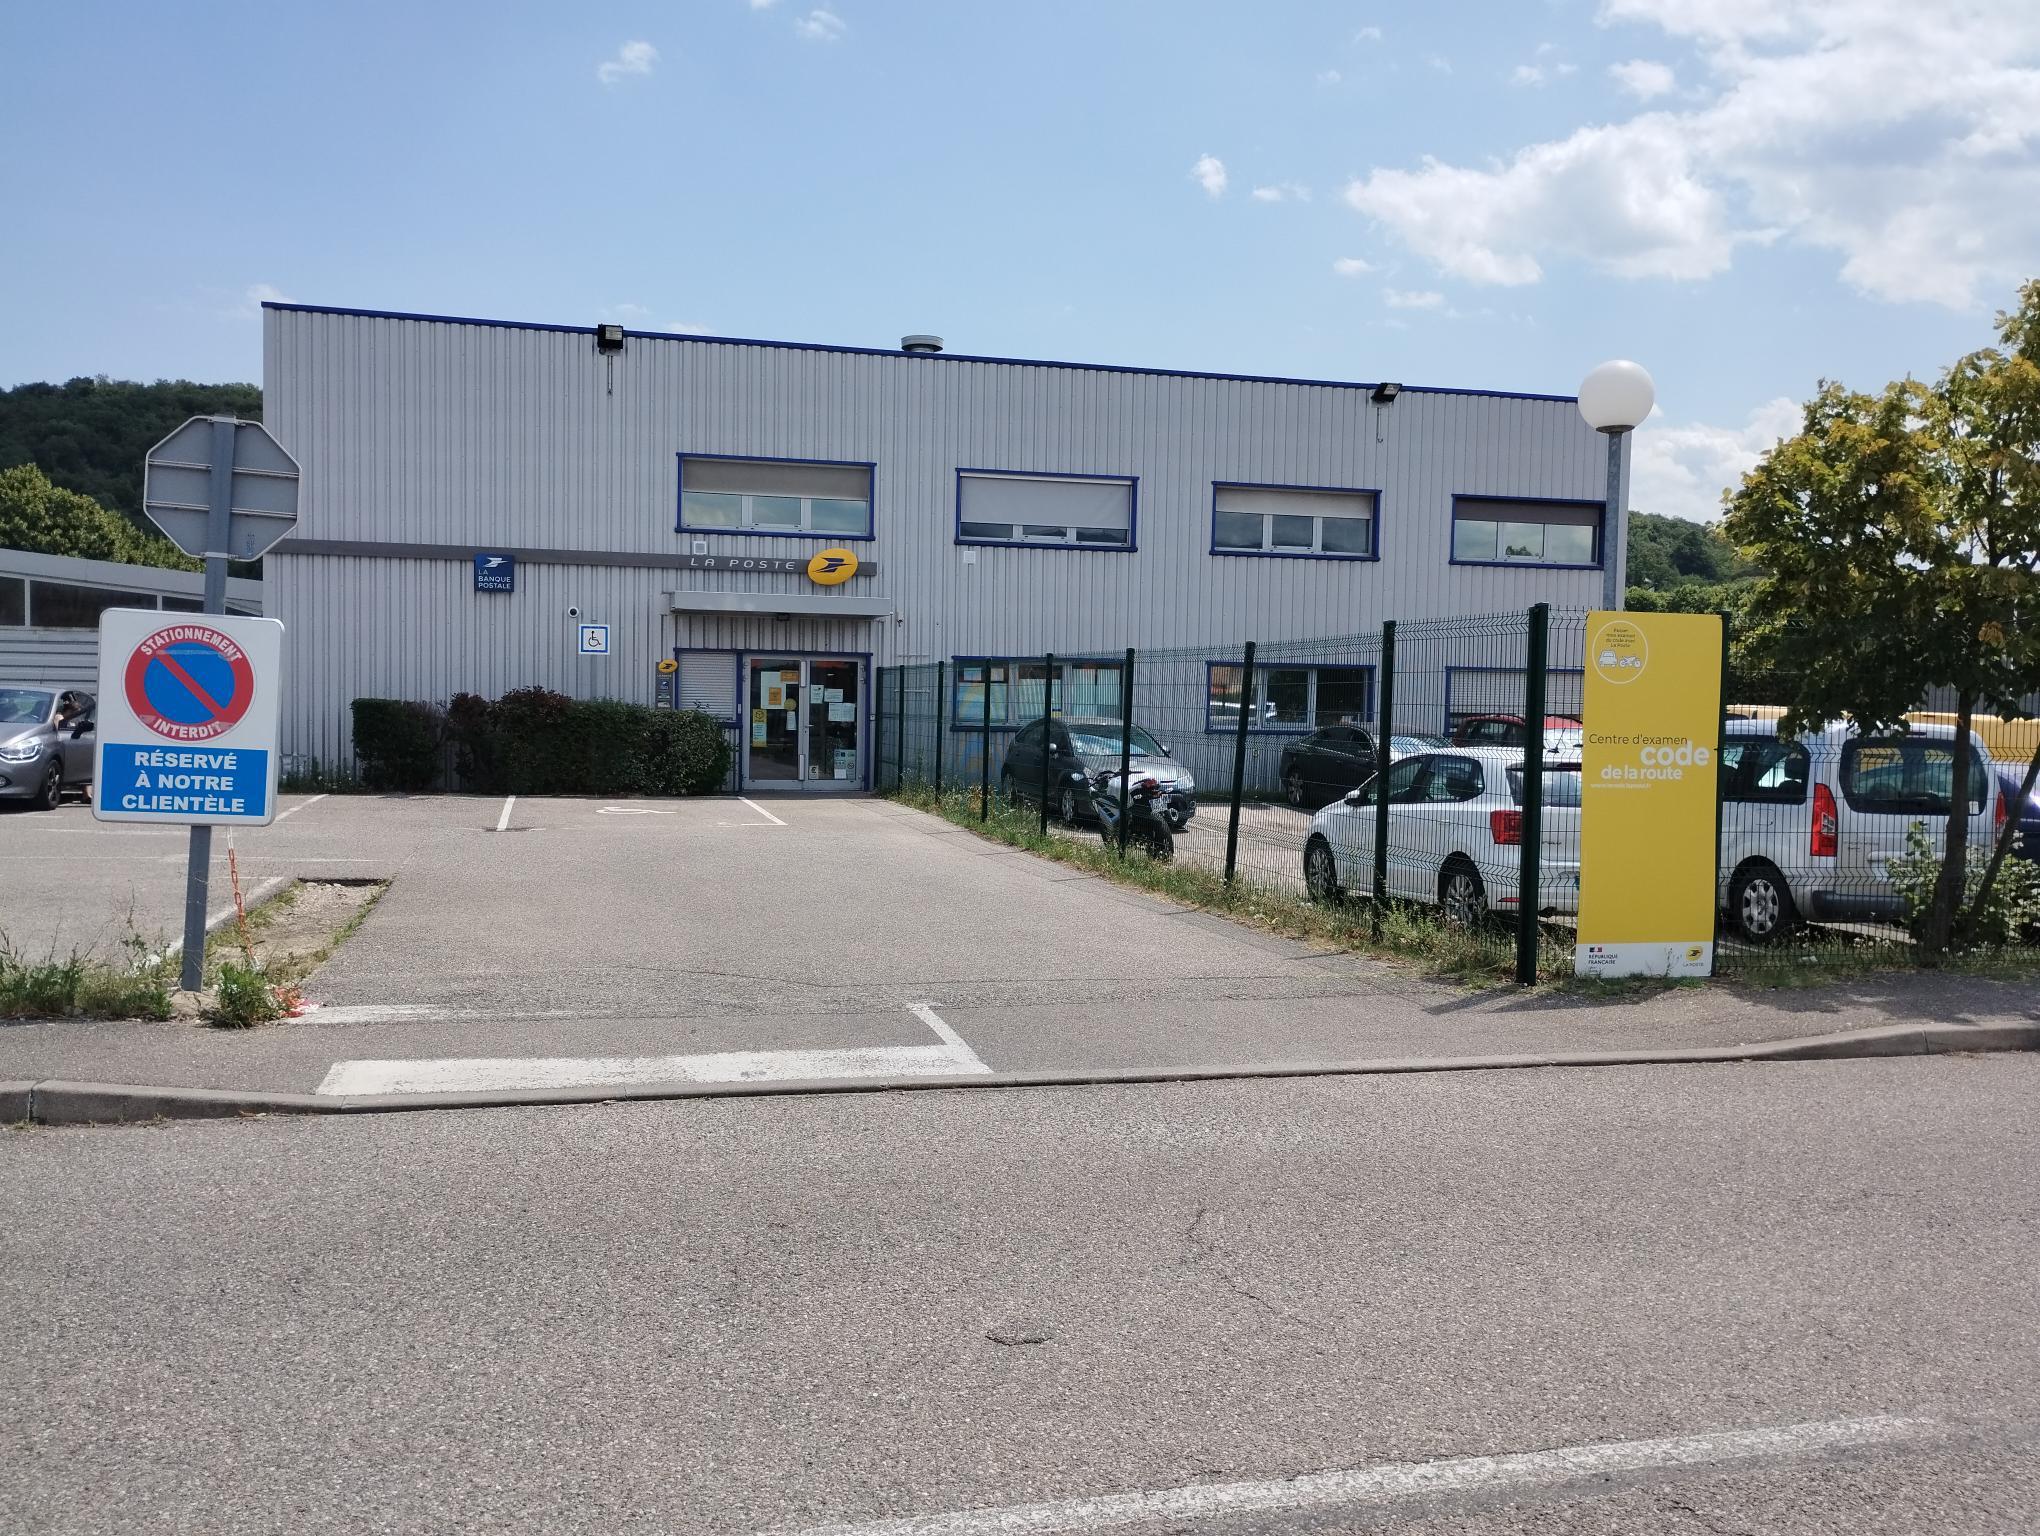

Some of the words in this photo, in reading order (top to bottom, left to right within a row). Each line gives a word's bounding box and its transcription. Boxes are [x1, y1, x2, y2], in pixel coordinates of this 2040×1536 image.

[690, 558, 715, 567] LA
[729, 559, 796, 570] POSTE
[140, 627, 243, 663] STATIONNEMENT
[153, 718, 222, 739] INTERDIT
[1588, 734, 1630, 745] Centre
[1632, 734, 1688, 745] d'examen
[134, 750, 238, 770] RÉSERVÉ
[1640, 740, 1710, 766] code
[135, 771, 151, 788] À
[158, 774, 234, 791] NOTRE
[1600, 765, 1622, 779] de
[1624, 765, 1638, 779] la
[1640, 766, 1683, 779] route
[121, 794, 245, 813] CLIENTÈLE
